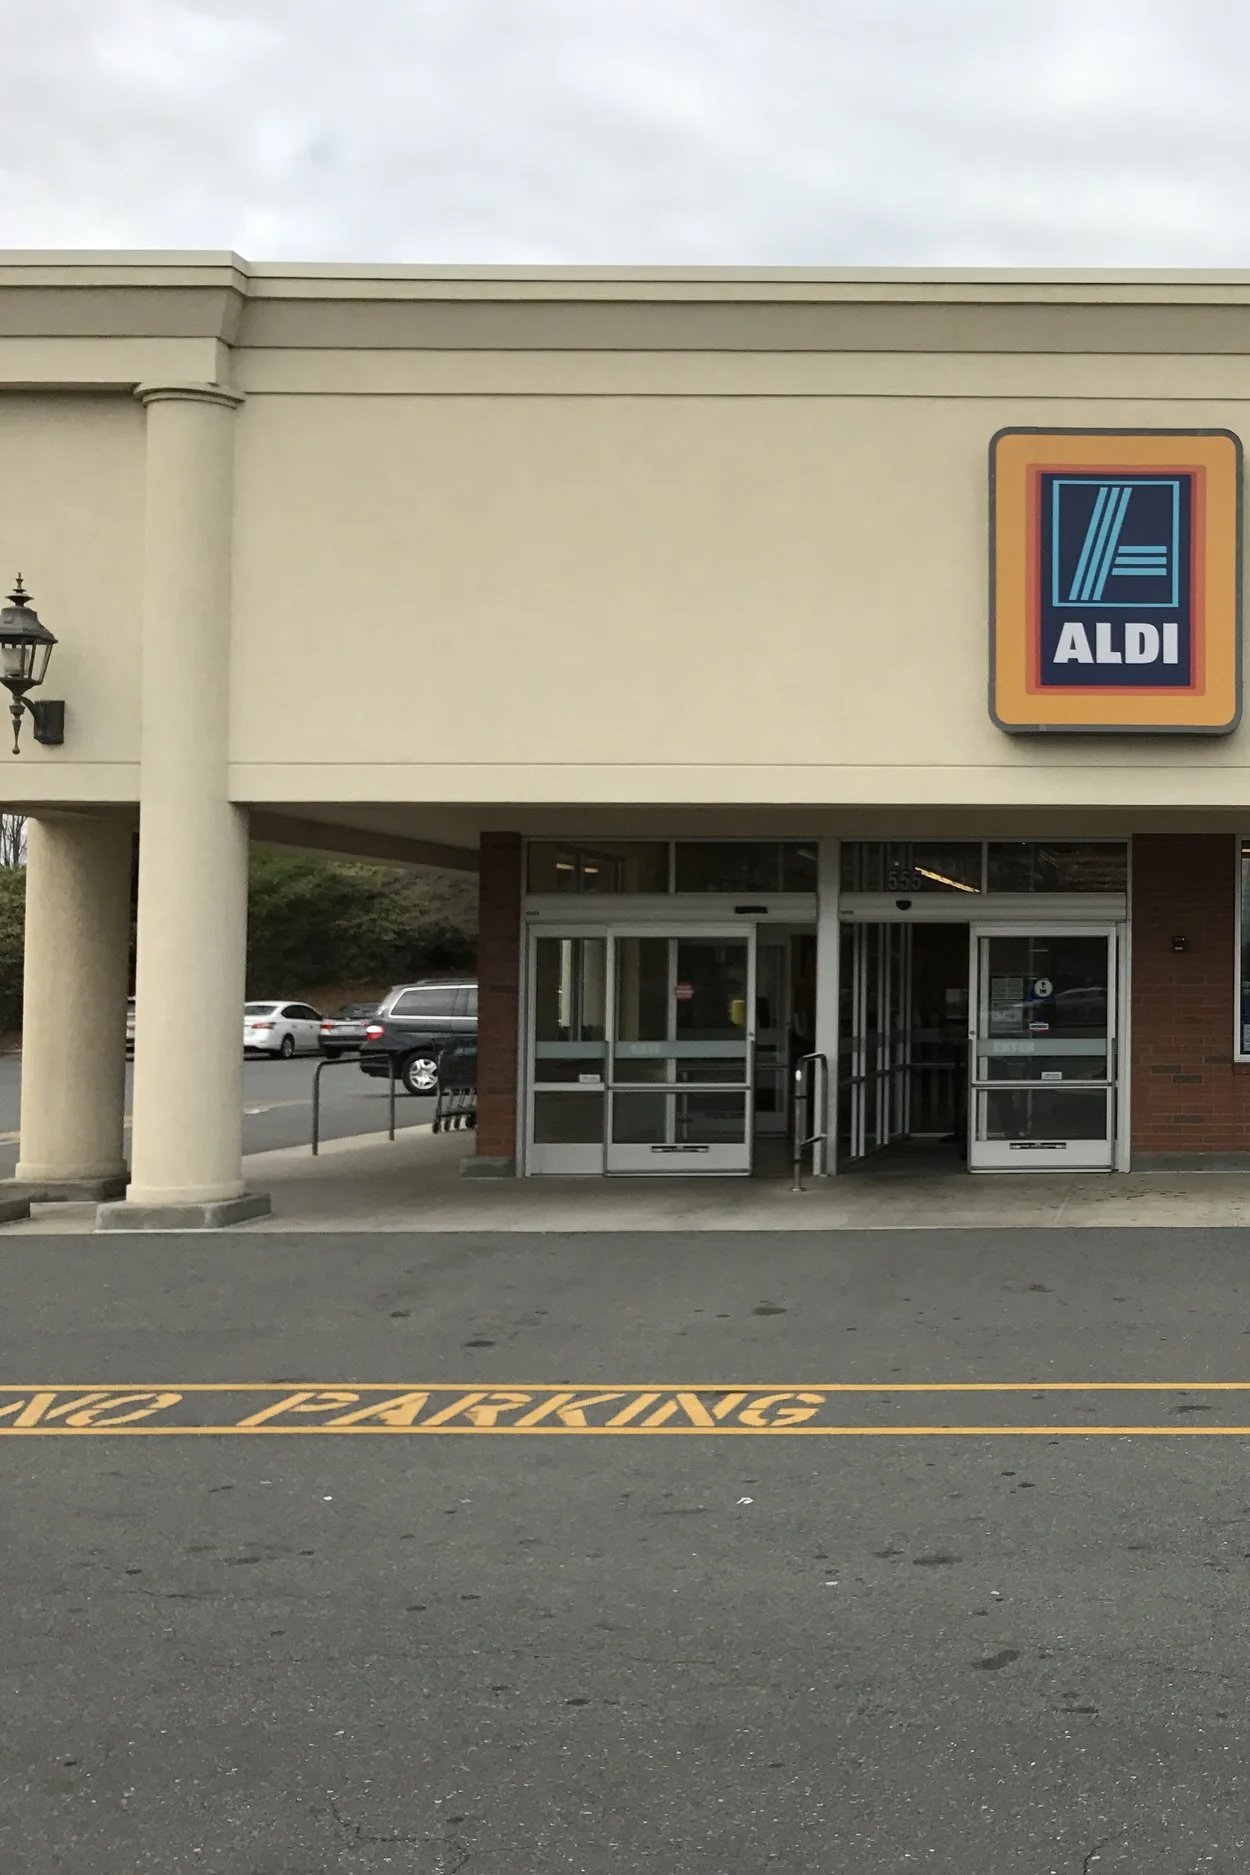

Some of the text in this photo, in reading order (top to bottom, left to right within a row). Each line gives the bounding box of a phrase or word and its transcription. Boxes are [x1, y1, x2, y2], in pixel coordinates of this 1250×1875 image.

[1053, 622, 1179, 664] ALDI
[888, 870, 922, 890] 555
[0, 1391, 826, 1428] NO PARKING
